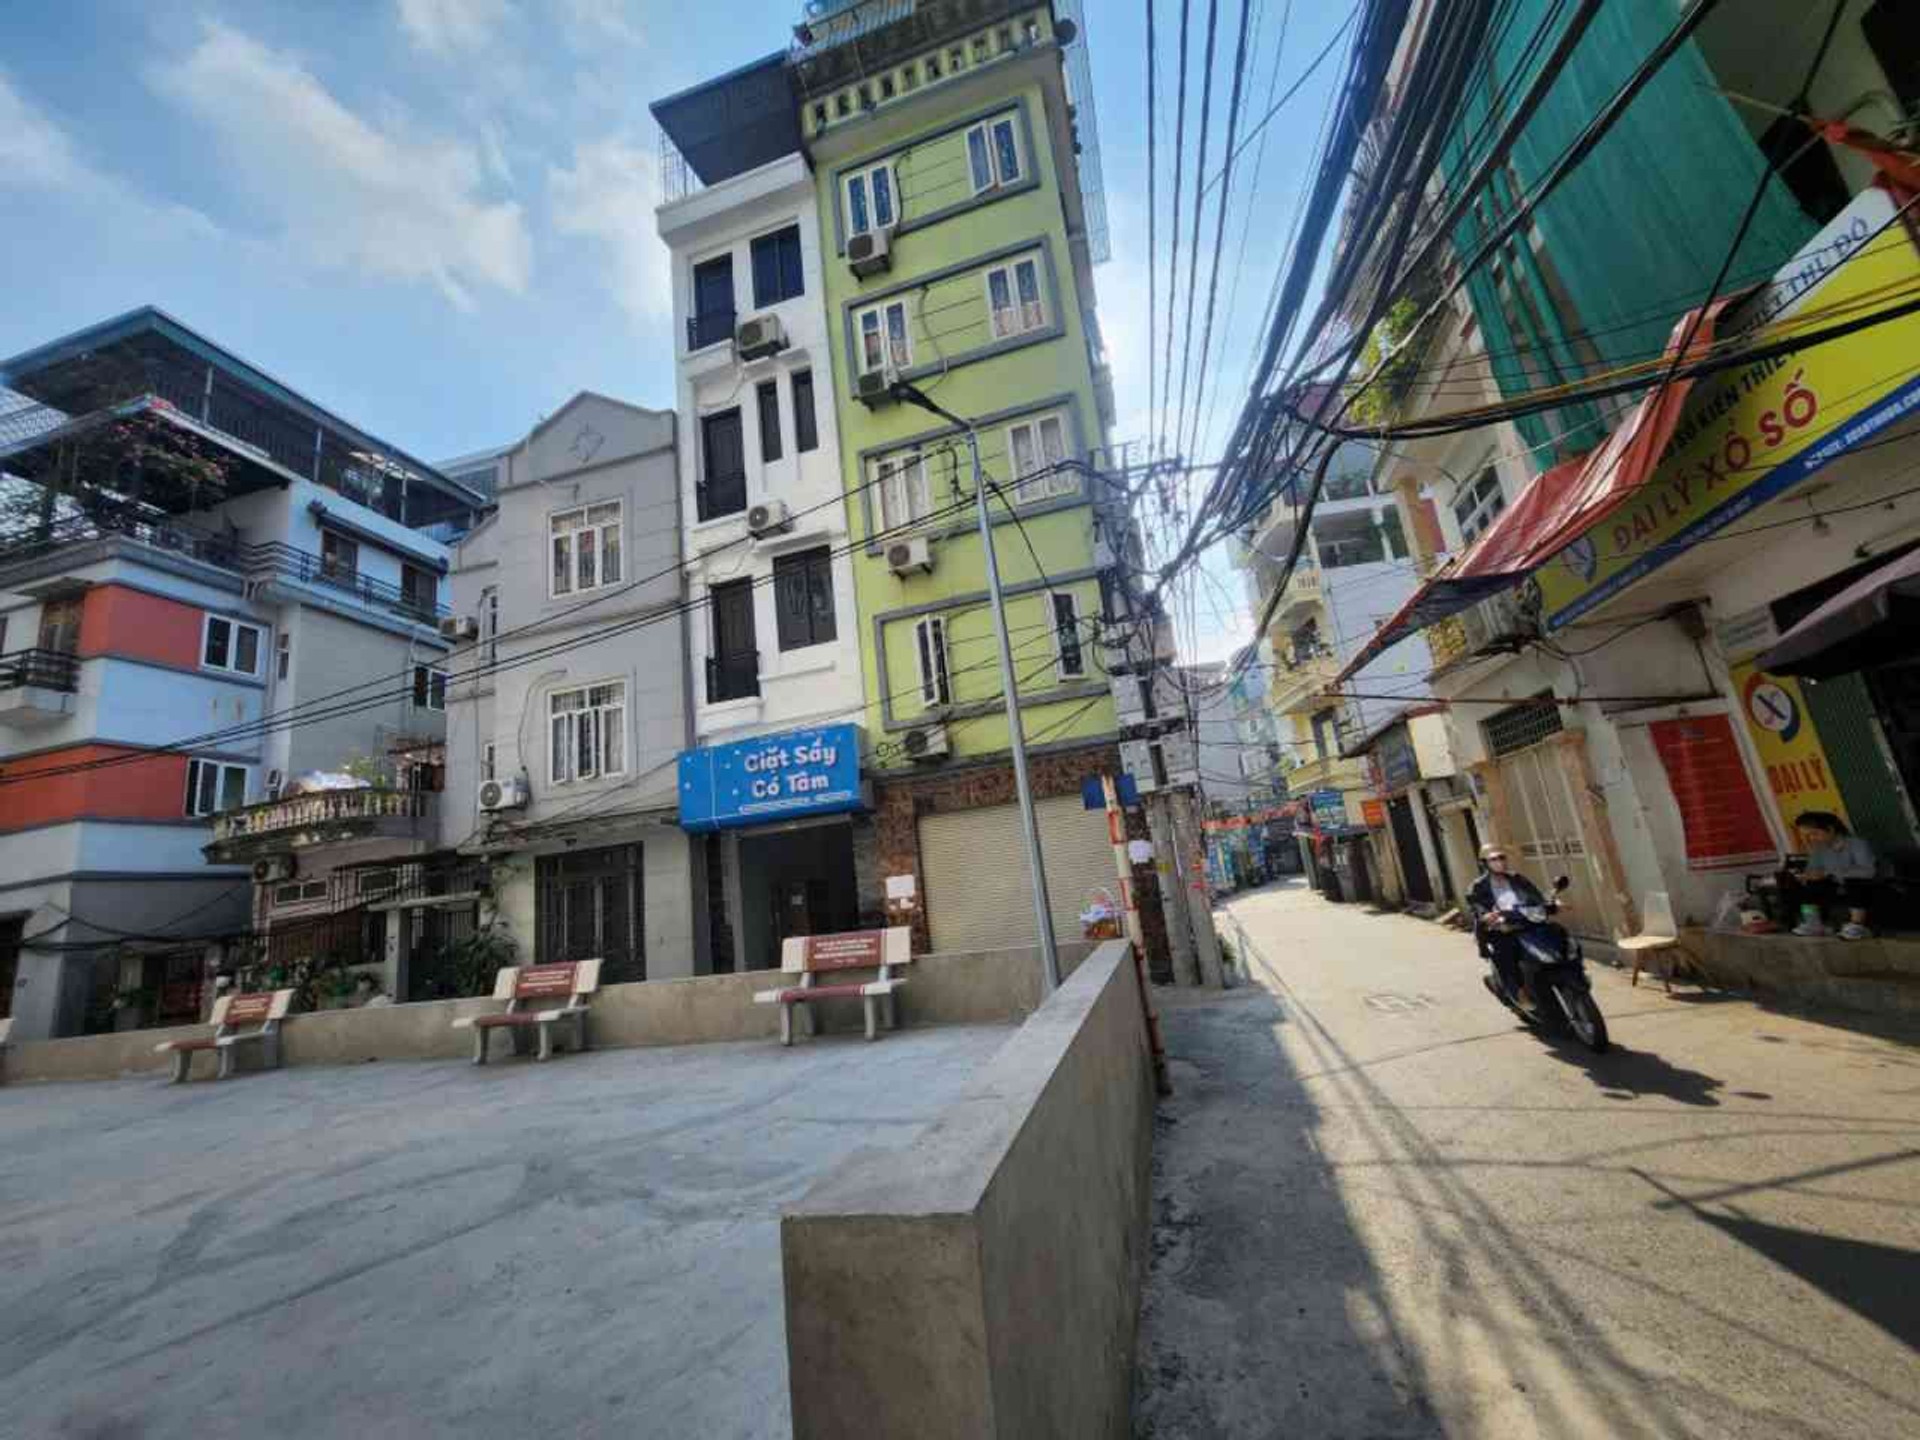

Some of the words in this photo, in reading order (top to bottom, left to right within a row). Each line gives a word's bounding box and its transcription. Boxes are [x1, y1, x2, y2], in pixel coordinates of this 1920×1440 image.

[1659, 467, 1692, 517] LÝ
[1699, 415, 1751, 490] XỔ
[1758, 367, 1818, 448] SỐ
[743, 746, 791, 774] Giặt
[794, 736, 836, 767] Sấy
[751, 775, 780, 798] Có
[787, 771, 830, 793] Tâm
